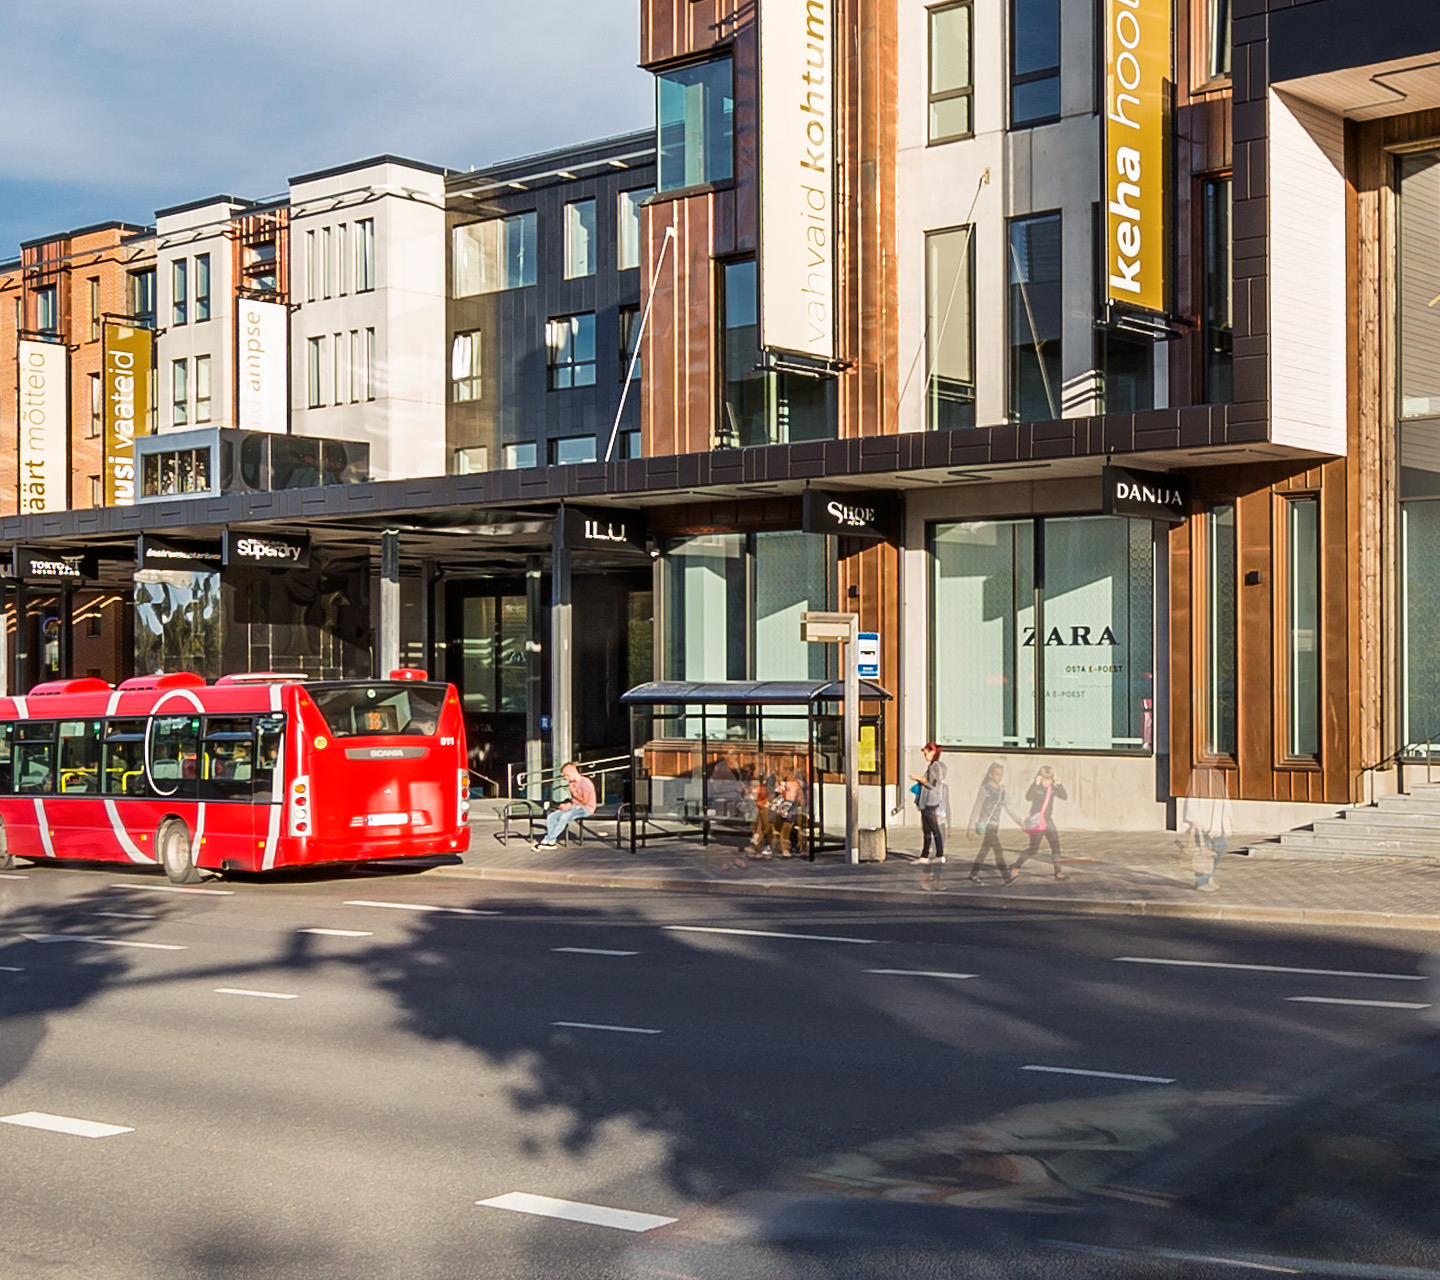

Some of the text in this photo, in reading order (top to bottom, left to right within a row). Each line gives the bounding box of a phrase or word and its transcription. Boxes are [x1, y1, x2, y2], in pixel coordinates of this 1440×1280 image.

[1109, 147, 1141, 293] keha
[800, 185, 826, 344] vahvaid
[108, 350, 135, 449] vaateid
[23, 459, 46, 514] äärt
[1116, 482, 1183, 506] DANIJA
[237, 539, 301, 561] Superdry
[30, 560, 67, 571] TOKYO
[1023, 625, 1120, 647] ZARA
[1066, 665, 1123, 673] OSTA E-POEST
